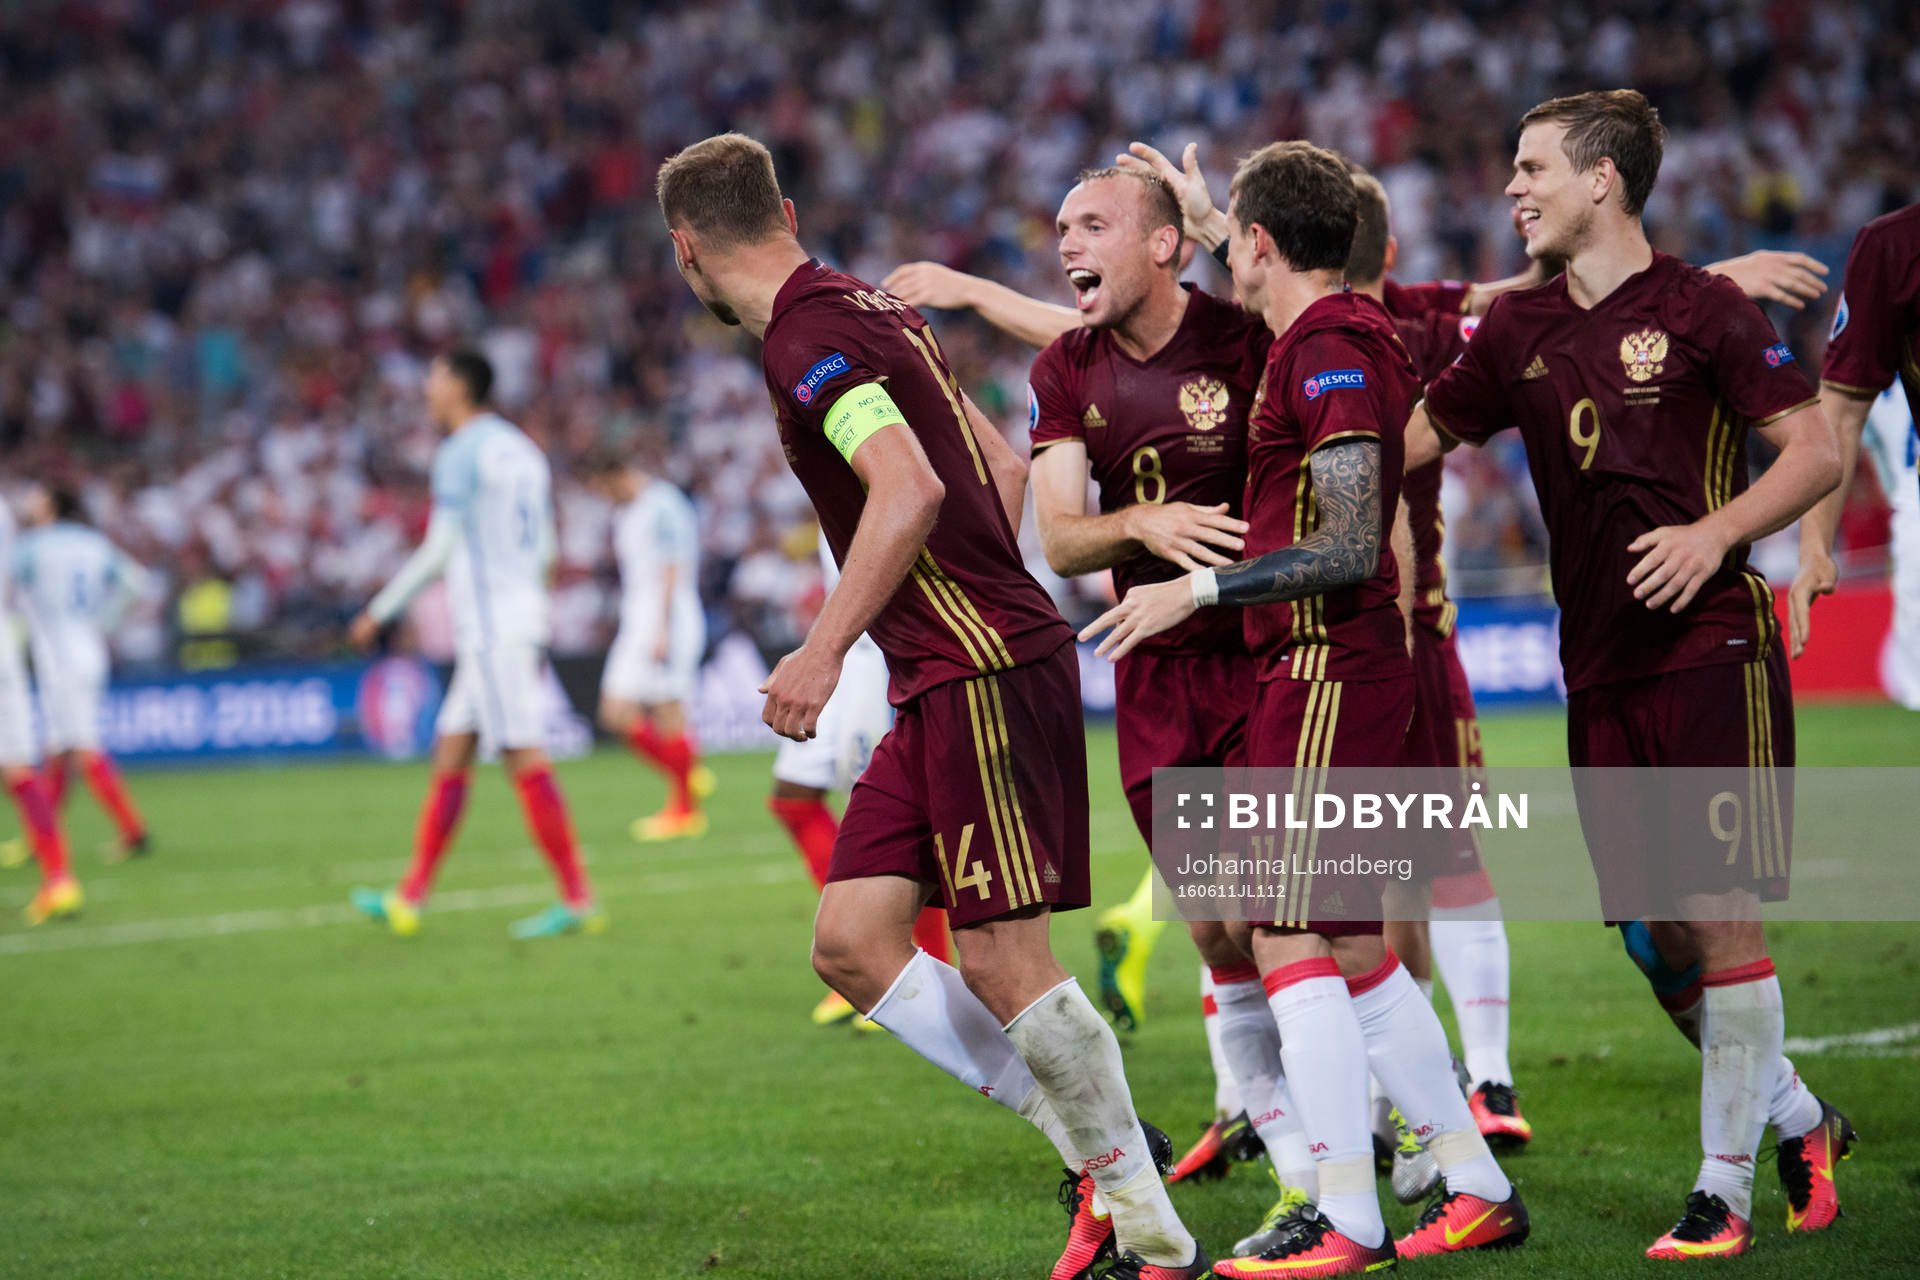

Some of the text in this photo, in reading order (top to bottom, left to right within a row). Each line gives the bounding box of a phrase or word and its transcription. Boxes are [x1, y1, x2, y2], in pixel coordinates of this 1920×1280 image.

[807, 356, 846, 389] RESPECT
[1319, 374, 1364, 388] RESPECT
[858, 397, 874, 408] NO
[1569, 397, 1601, 471] 9
[1132, 446, 1167, 505] 8
[1708, 791, 1742, 865] 9
[934, 822, 993, 908] 14
